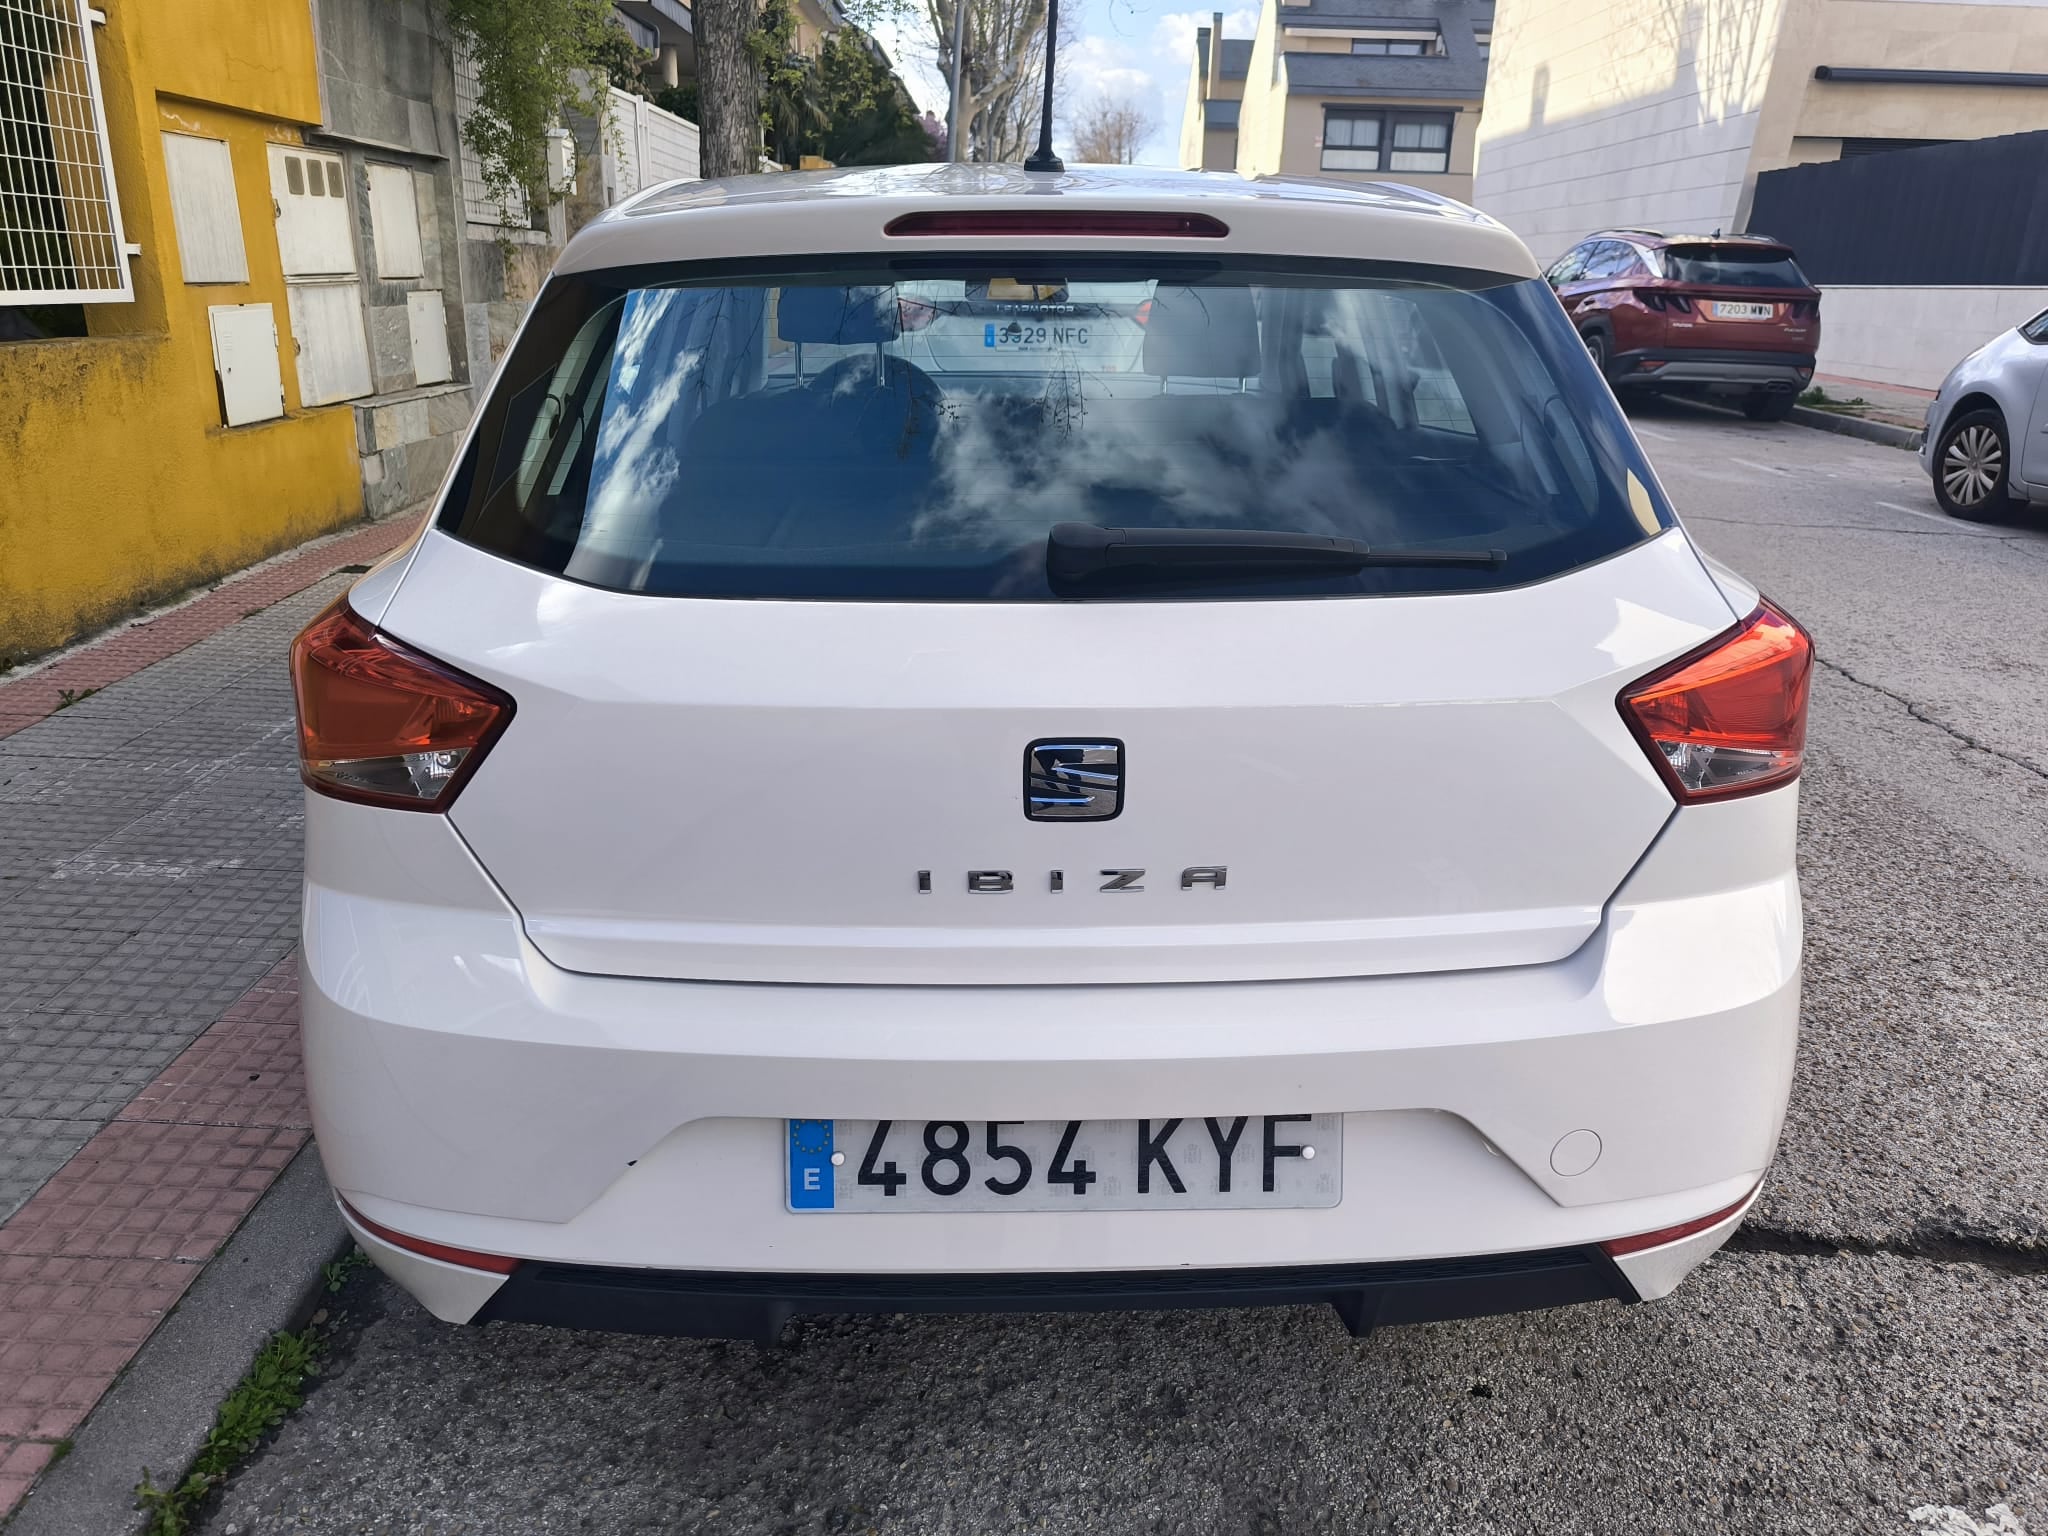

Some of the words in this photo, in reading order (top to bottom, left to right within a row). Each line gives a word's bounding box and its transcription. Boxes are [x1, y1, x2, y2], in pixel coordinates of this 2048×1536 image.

[1720, 303, 1747, 315] 7203
[1053, 327, 1088, 345] NFC
[917, 866, 1228, 894] IBIZA
[858, 1120, 1097, 1196] 4854
[1137, 1114, 1312, 1194] KYF
[804, 1168, 821, 1190] E
